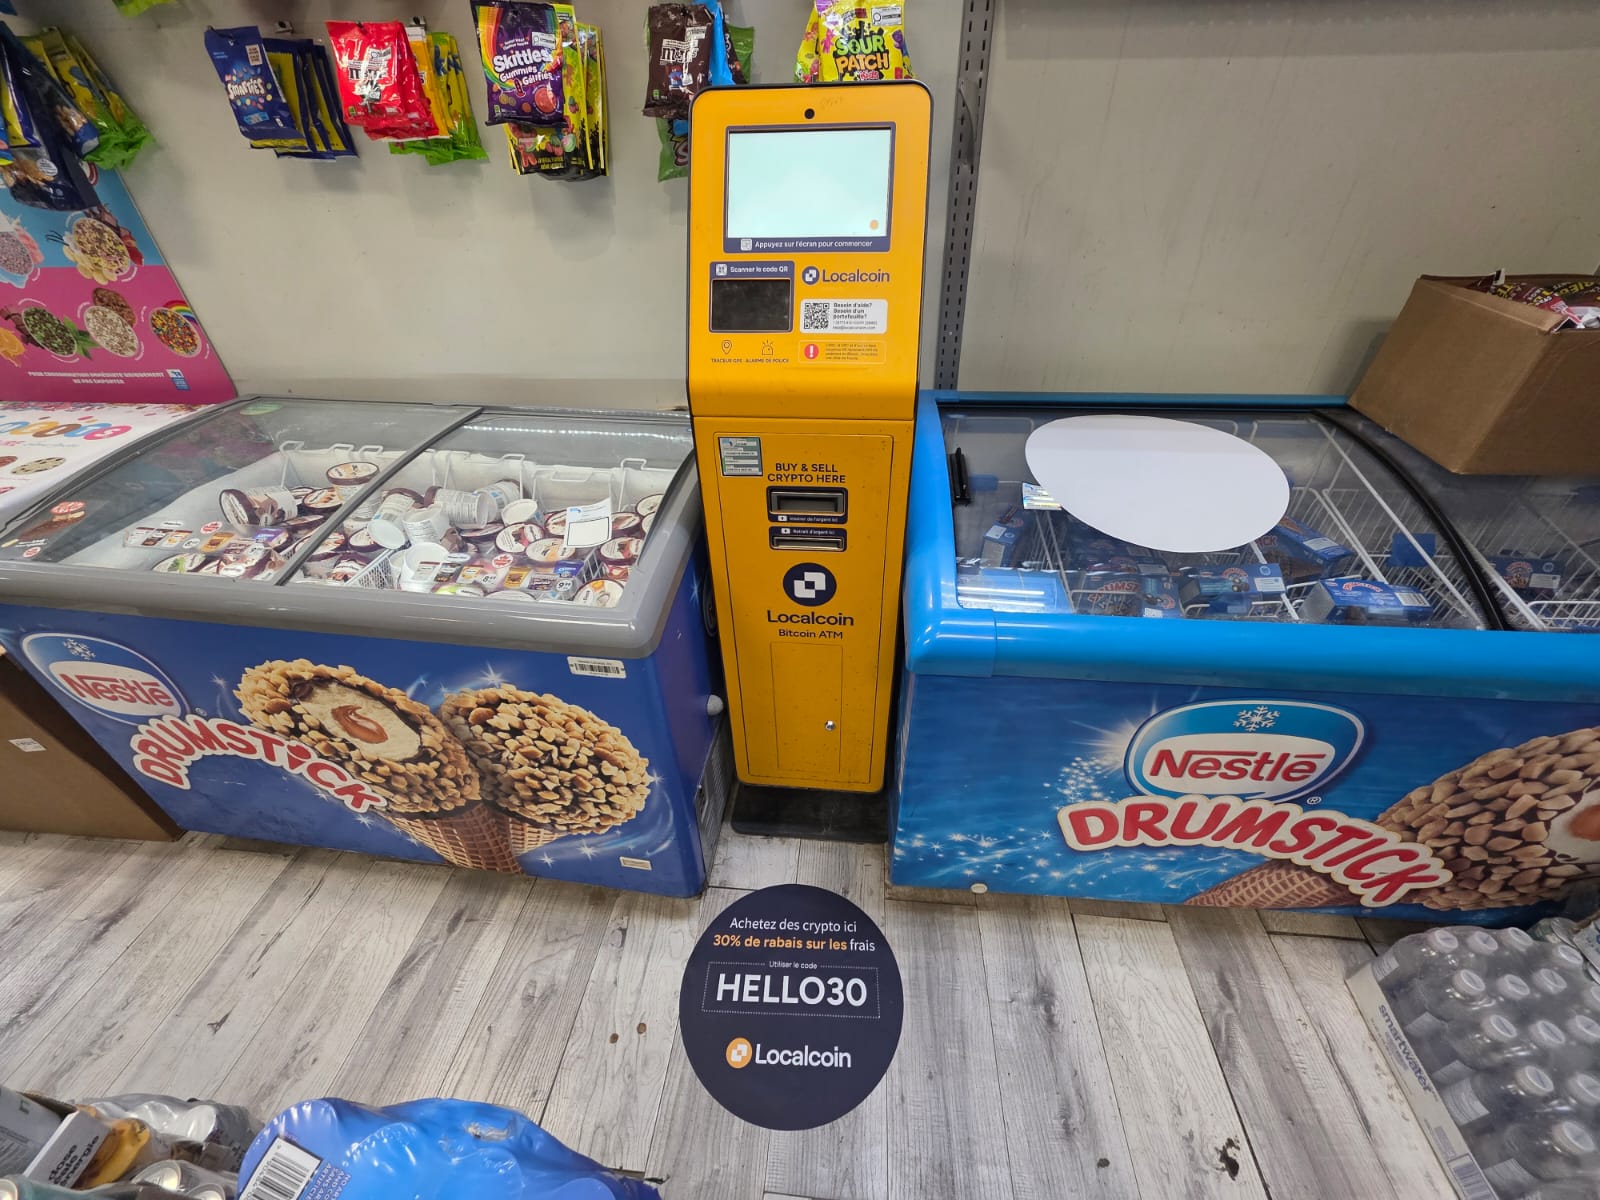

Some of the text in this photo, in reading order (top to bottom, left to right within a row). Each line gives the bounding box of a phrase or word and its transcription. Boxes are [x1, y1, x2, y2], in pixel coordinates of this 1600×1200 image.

[835, 34, 884, 55] SOUR
[493, 48, 553, 72] Skittles
[835, 52, 890, 74] PATCH
[500, 65, 538, 82] Gummies
[755, 240, 783, 248] Appuyez
[822, 268, 890, 284] Localcoin
[776, 463, 838, 472] BUY & SELL
[768, 474, 846, 483] CRYPTO HERE
[767, 610, 854, 626] Localcoin
[778, 629, 843, 639] Bitcoin ATM
[134, 716, 385, 811] DRUMSTICK
[1063, 799, 1446, 904] DRUMSTICK
[730, 918, 857, 934] Achetez des crypto ici
[713, 935, 875, 952] 30% de rabais sur les frais
[716, 973, 867, 1006] HELLO30
[755, 1044, 852, 1068] Localcoin
[1379, 1004, 1432, 1092] smartwater
[341, 1174, 351, 1186] NO
